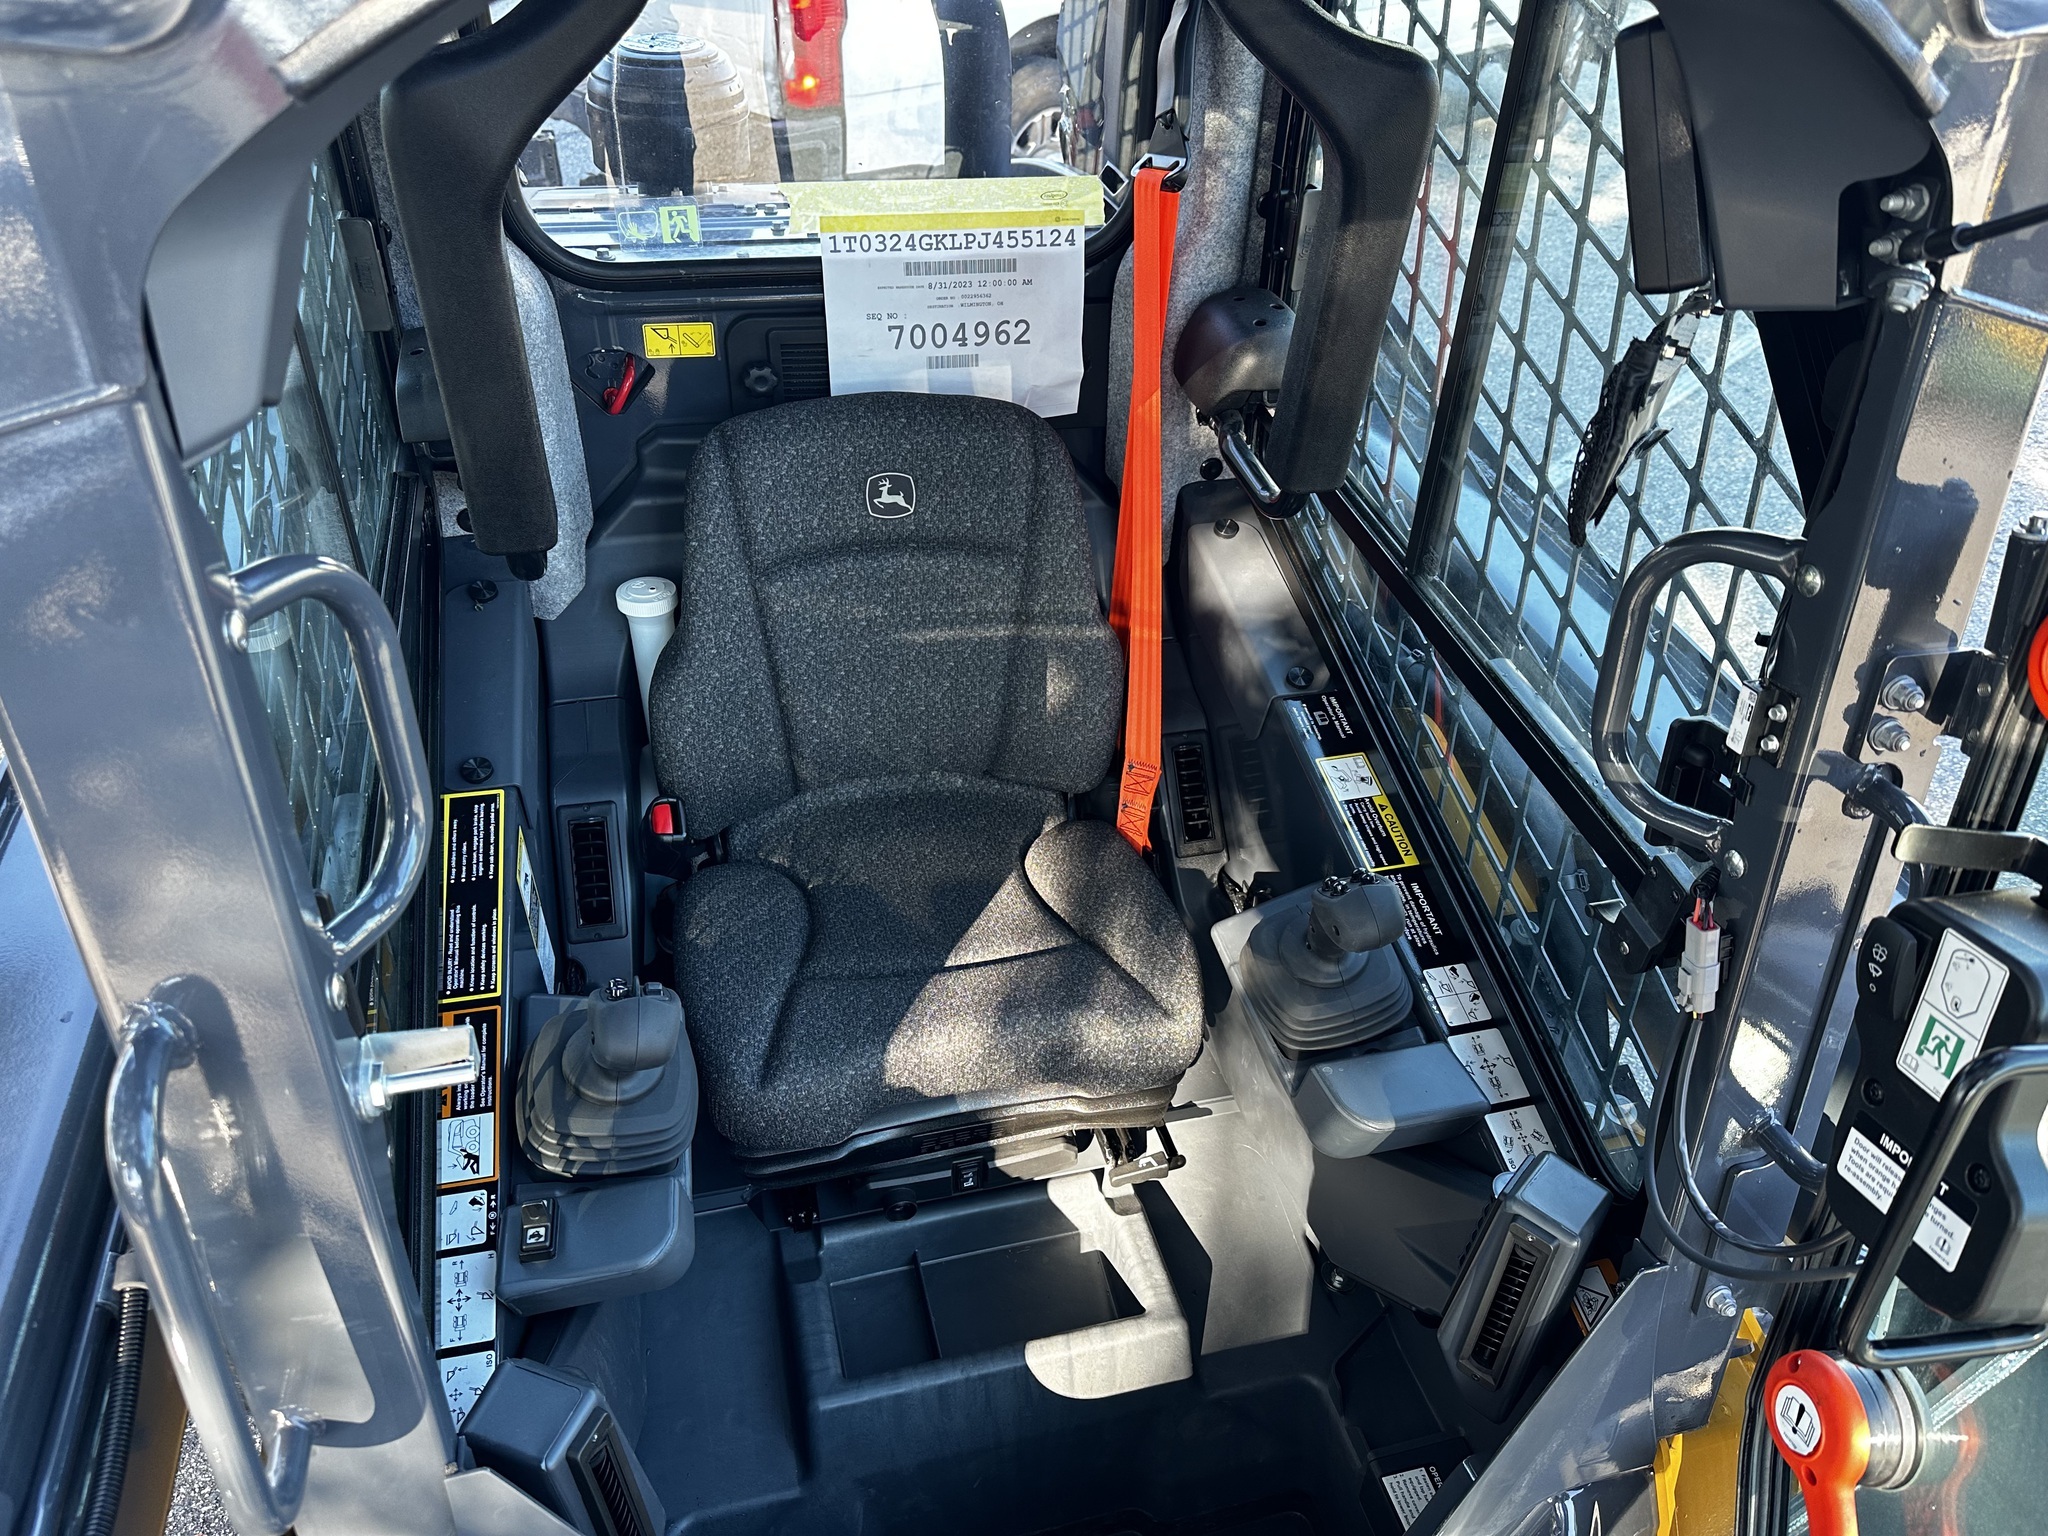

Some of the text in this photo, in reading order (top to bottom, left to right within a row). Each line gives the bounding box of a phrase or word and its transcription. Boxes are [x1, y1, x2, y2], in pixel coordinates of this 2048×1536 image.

[828, 228, 1077, 254] 1T0324GKLPJ455124
[927, 281, 973, 291] 8/31/2023
[977, 279, 1017, 288] 12:00:00
[866, 313, 883, 321] SEQ
[887, 319, 1031, 350] 7004962
[1329, 696, 1353, 734] IMPORTANT
[1363, 797, 1386, 836] Avoid Overturn
[1384, 813, 1412, 856] CAUTION
[1397, 880, 1412, 900] prevent
[1409, 900, 1422, 920] damage
[1422, 927, 1439, 955] hydraulics
[1410, 882, 1442, 934] IMPORTANT
[1404, 918, 1412, 927] run
[1412, 934, 1422, 947] slow
[1407, 909, 1427, 944] temperatures
[1507, 1158, 1517, 1170] ISO
[1848, 1154, 1864, 1173] Tools
[1864, 1171, 1875, 1182] are
[1875, 1180, 1893, 1197] requi
[1850, 1147, 1867, 1164] when
[1868, 1162, 1890, 1183] orange
[1853, 1136, 1901, 1181] Door will releas
[485, 1353, 493, 1368] ISO
